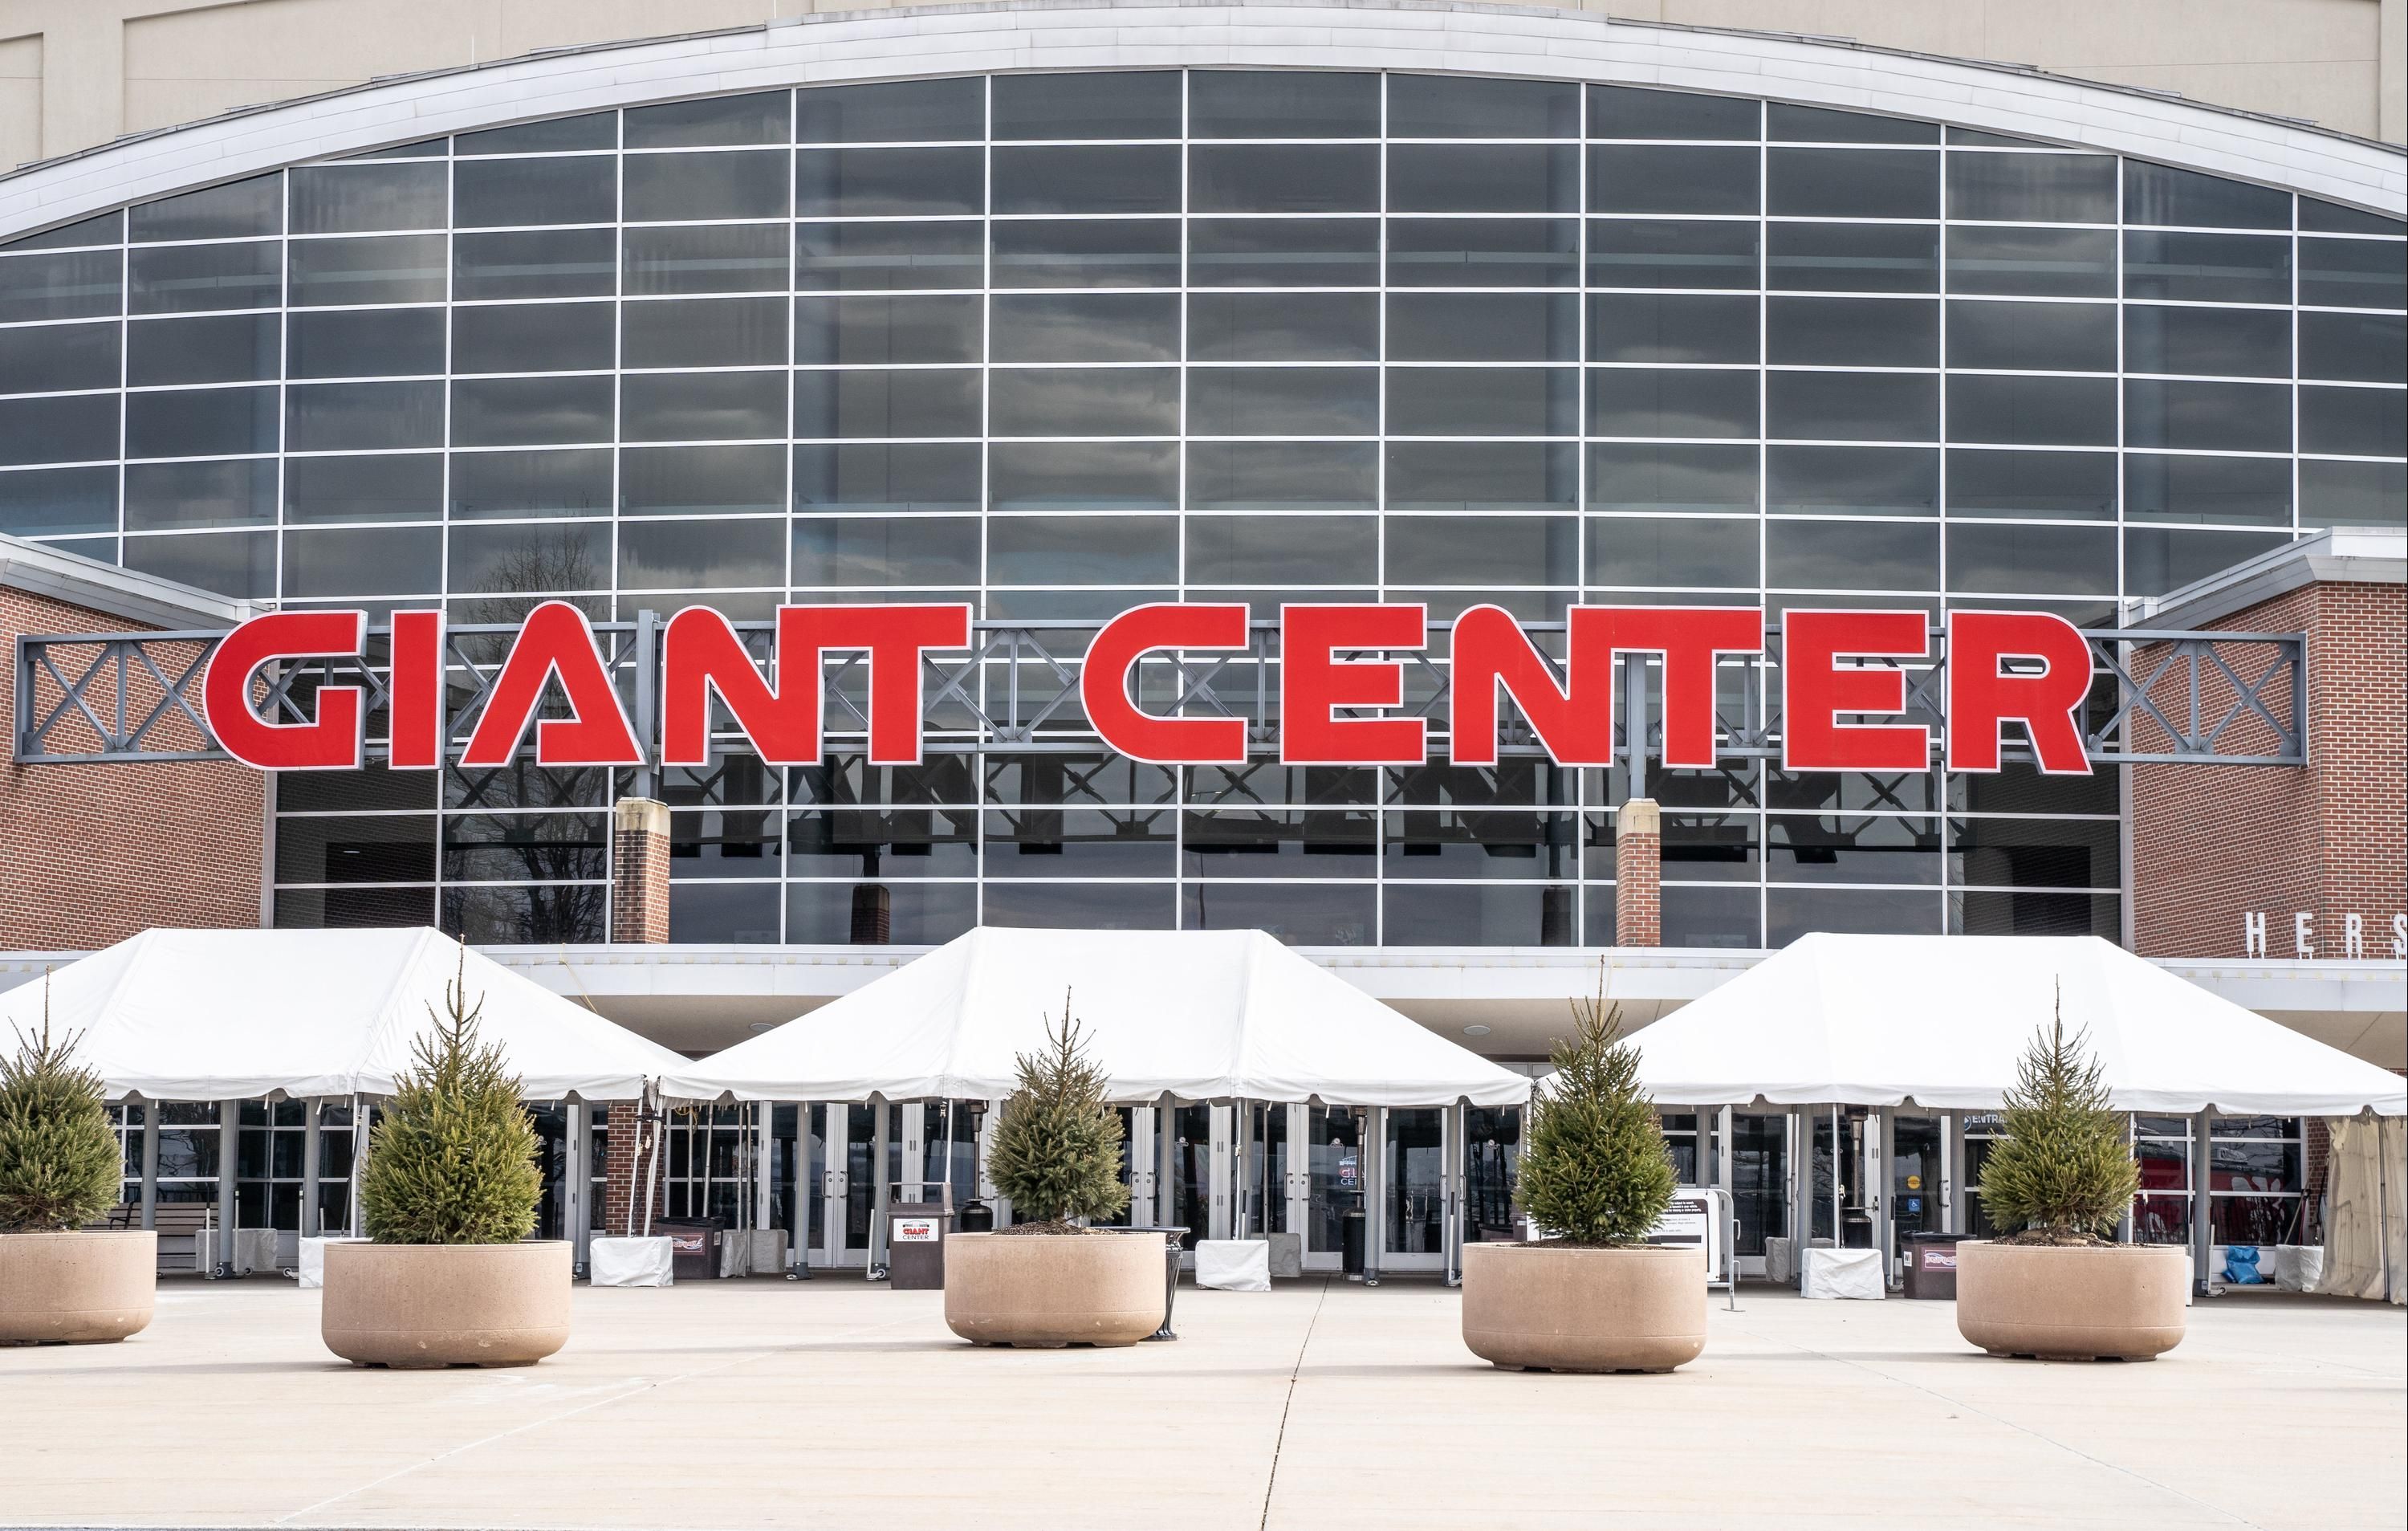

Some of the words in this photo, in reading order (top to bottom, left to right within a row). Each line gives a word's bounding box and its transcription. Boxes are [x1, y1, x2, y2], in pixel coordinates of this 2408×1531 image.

[202, 601, 974, 772] GIANT
[1080, 602, 2094, 776] CENTER
[2245, 912, 2407, 955] HERS
[1972, 1114, 2007, 1124] ENTRA
